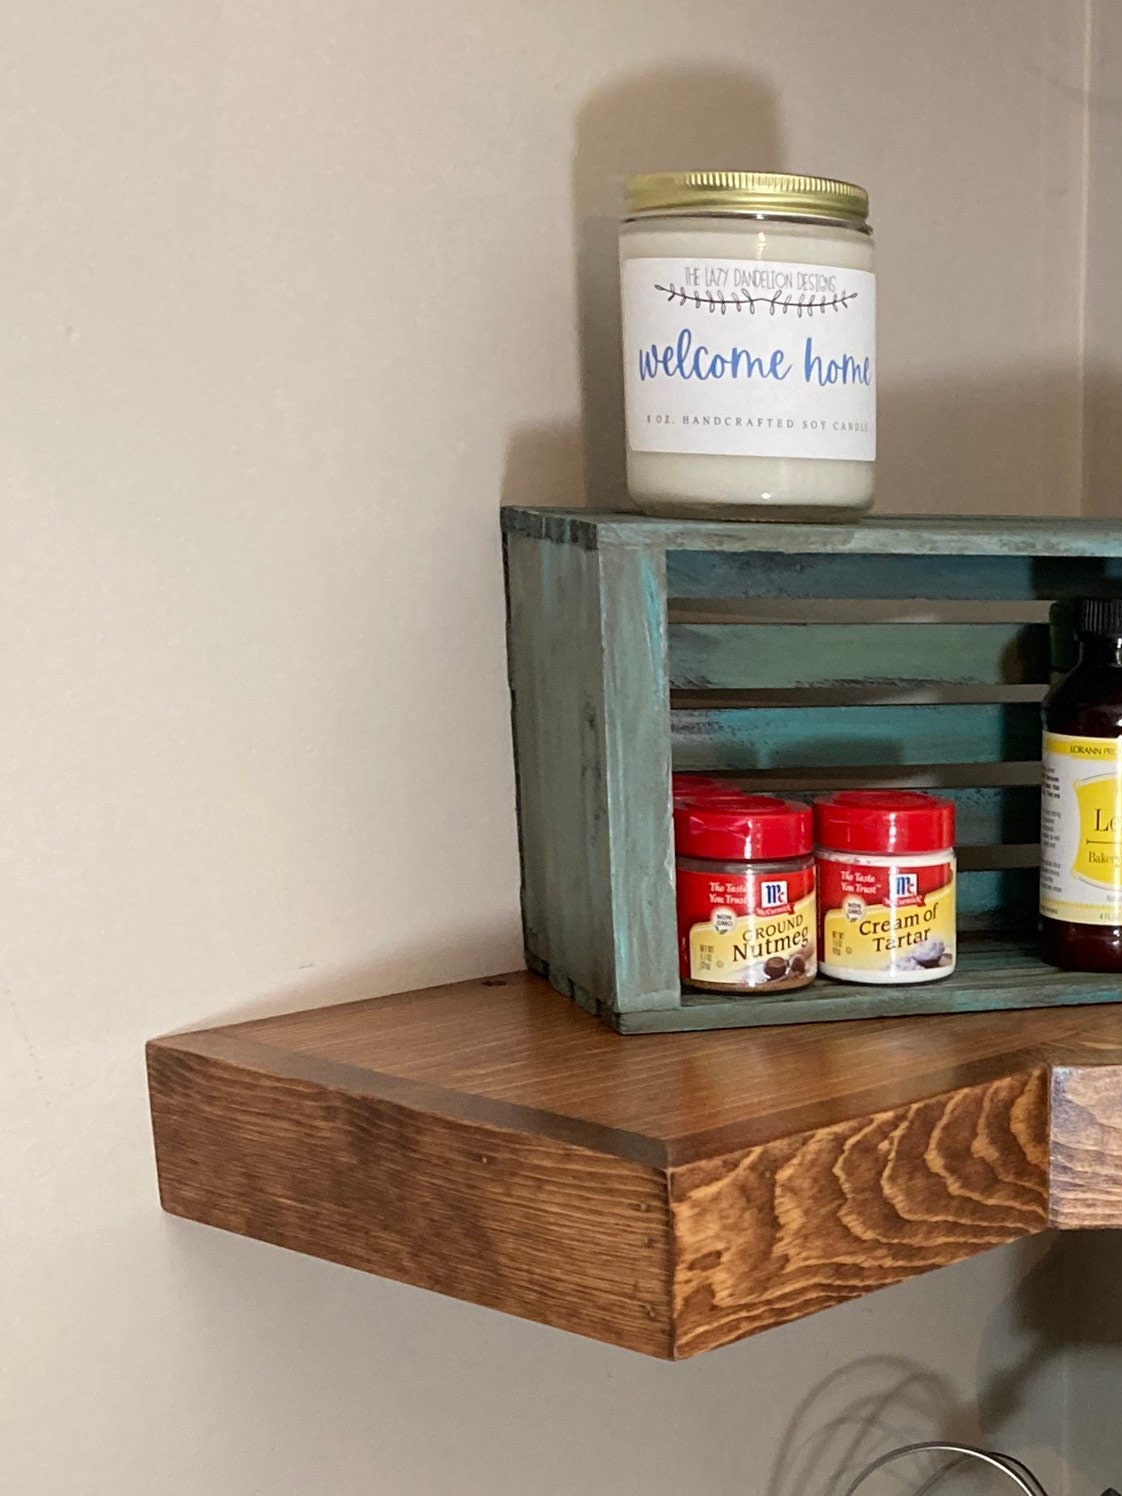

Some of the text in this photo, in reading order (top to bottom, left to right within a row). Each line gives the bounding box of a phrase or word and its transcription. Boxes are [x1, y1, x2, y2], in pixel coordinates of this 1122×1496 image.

[685, 267, 836, 292] THE LAZY DANDELION DESIGNS
[639, 328, 871, 387] welcome home
[683, 415, 794, 429] HANDCRAFTED
[802, 420, 826, 430] SOY
[709, 881, 724, 893] The
[841, 871, 876, 883] The Taste
[841, 882, 854, 892] You
[709, 894, 724, 904] You
[742, 914, 804, 942] GROUND
[859, 902, 939, 936] Cream of
[732, 926, 809, 962] Nutmeg
[872, 928, 931, 952] Tartar
